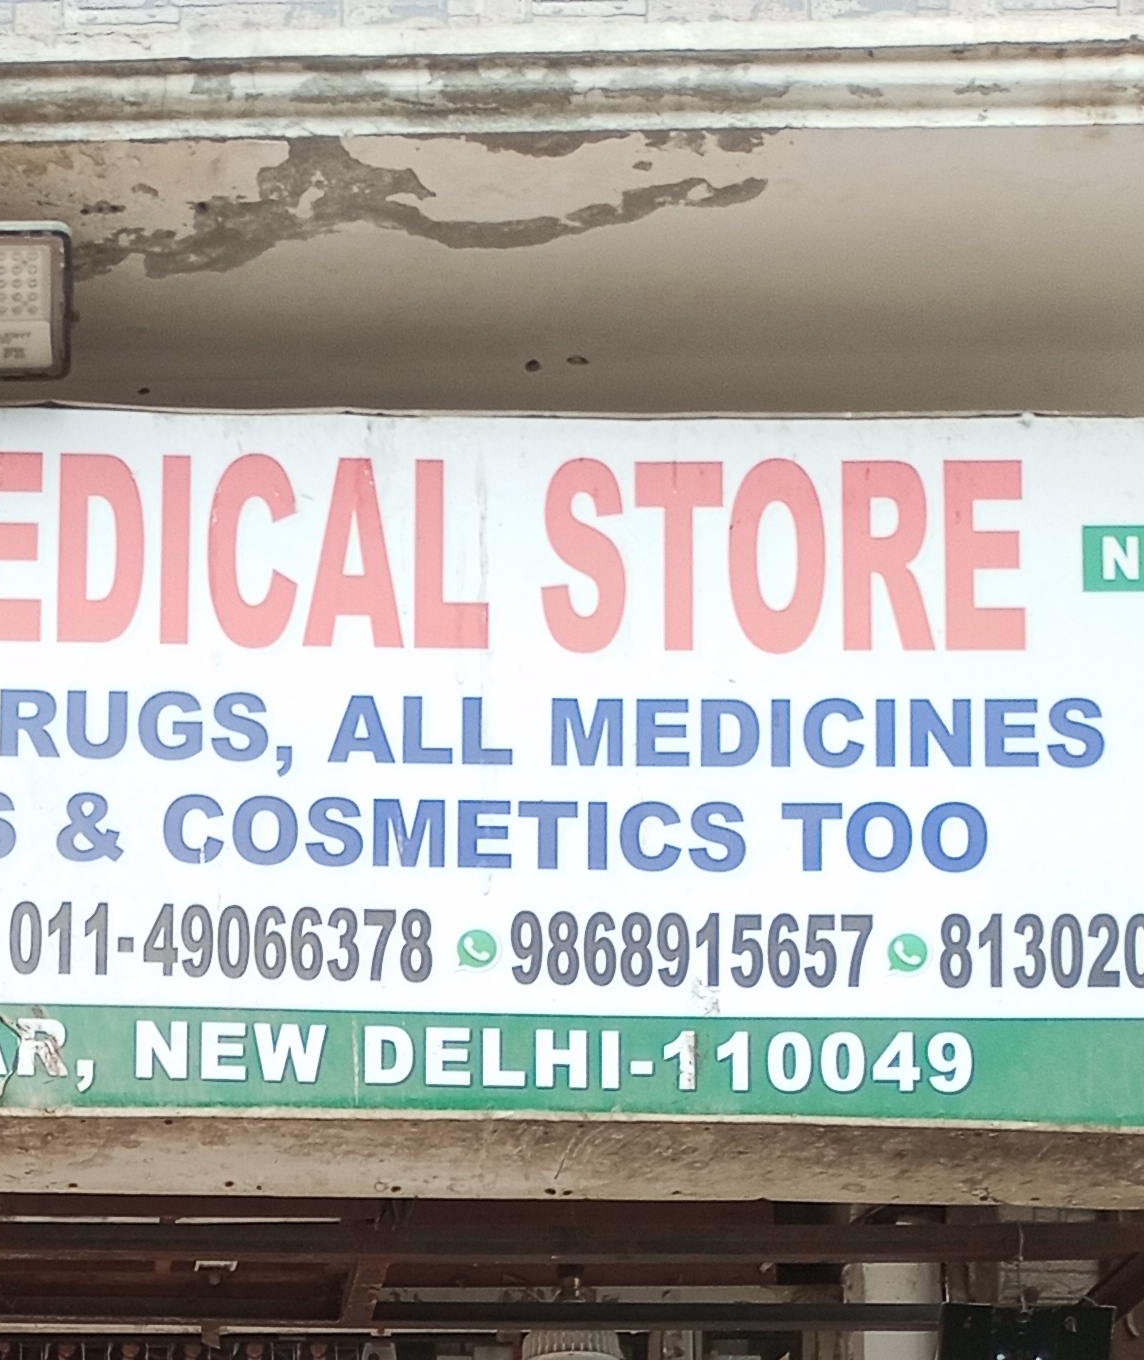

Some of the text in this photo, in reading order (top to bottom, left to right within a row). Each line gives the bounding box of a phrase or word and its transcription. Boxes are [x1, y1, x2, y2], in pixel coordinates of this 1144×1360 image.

[541, 456, 1027, 655] STORE
[1102, 535, 1139, 581] N
[327, 694, 514, 767] ALL
[549, 695, 1106, 770] MEDICINES
[55, 790, 126, 865] &
[162, 794, 748, 874] COSMETICS
[782, 800, 990, 874] TOO
[9, 900, 434, 984] 011-49066378
[510, 908, 874, 989] 9868915657
[133, 1019, 328, 1085] NEW
[362, 1026, 974, 1096] DELHI-110049
